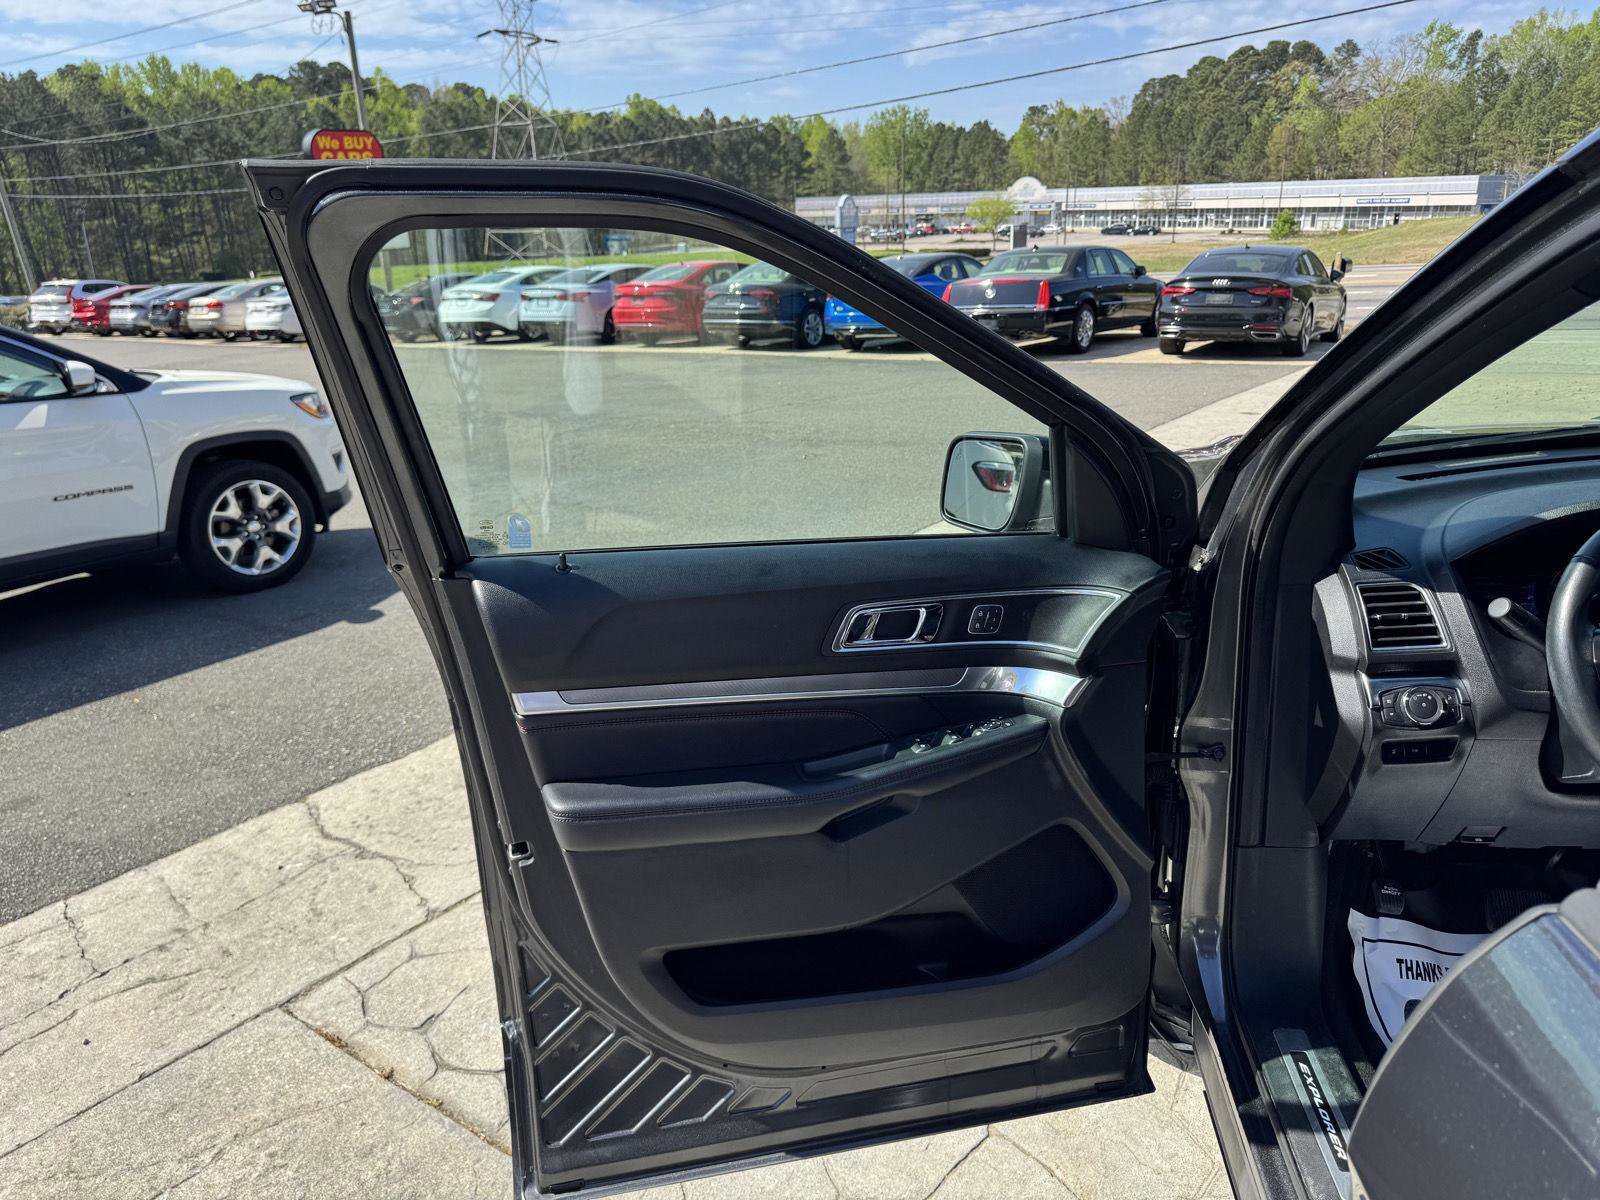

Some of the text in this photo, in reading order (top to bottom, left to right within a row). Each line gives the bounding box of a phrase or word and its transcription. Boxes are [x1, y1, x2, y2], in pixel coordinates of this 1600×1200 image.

[315, 135, 374, 150] We BUY
[53, 484, 134, 502] COMPASS
[1396, 958, 1443, 983] THANKS
[1298, 1061, 1348, 1161] EXPLORER
